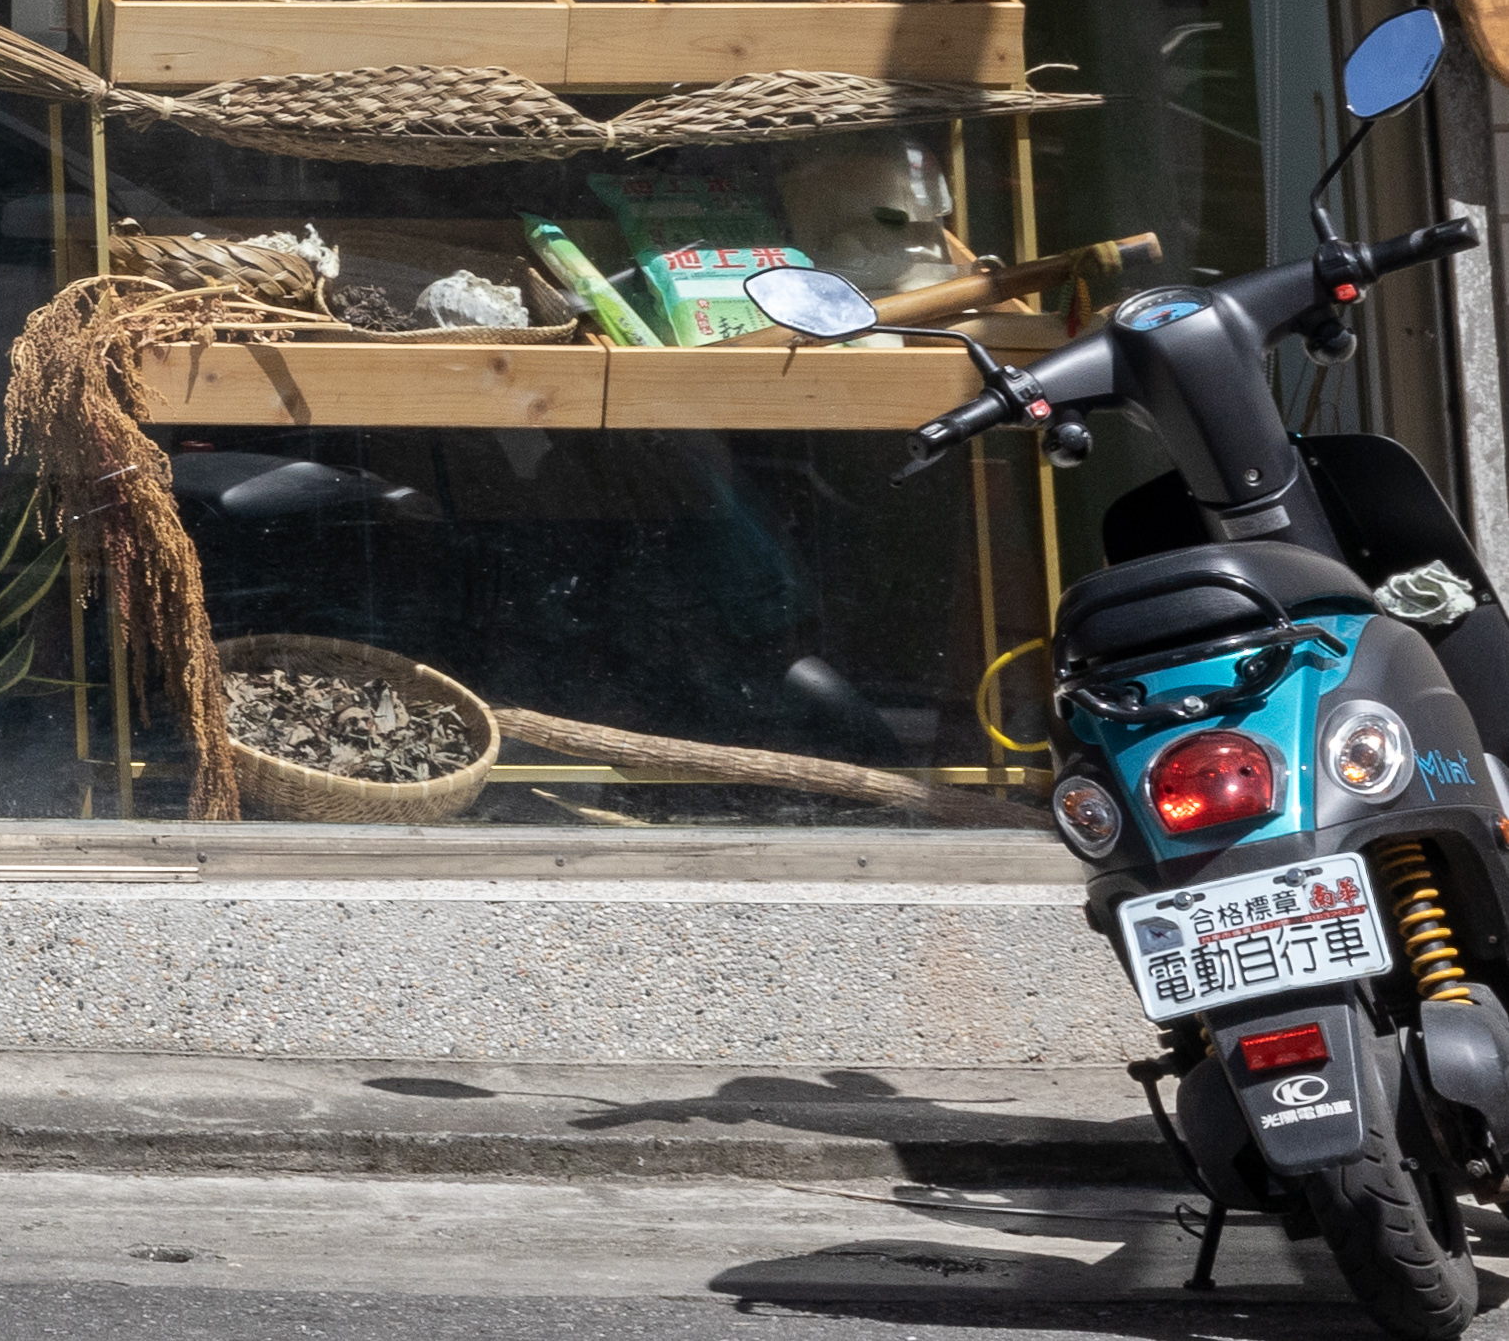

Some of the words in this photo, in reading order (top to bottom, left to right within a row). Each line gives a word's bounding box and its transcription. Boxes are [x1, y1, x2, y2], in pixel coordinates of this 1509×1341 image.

[662, 248, 790, 271] 池上米
[1189, 889, 1301, 936] 合格標章
[1148, 917, 1370, 1004] 電動自行車
[1261, 1100, 1353, 1129] 光陽電動車
